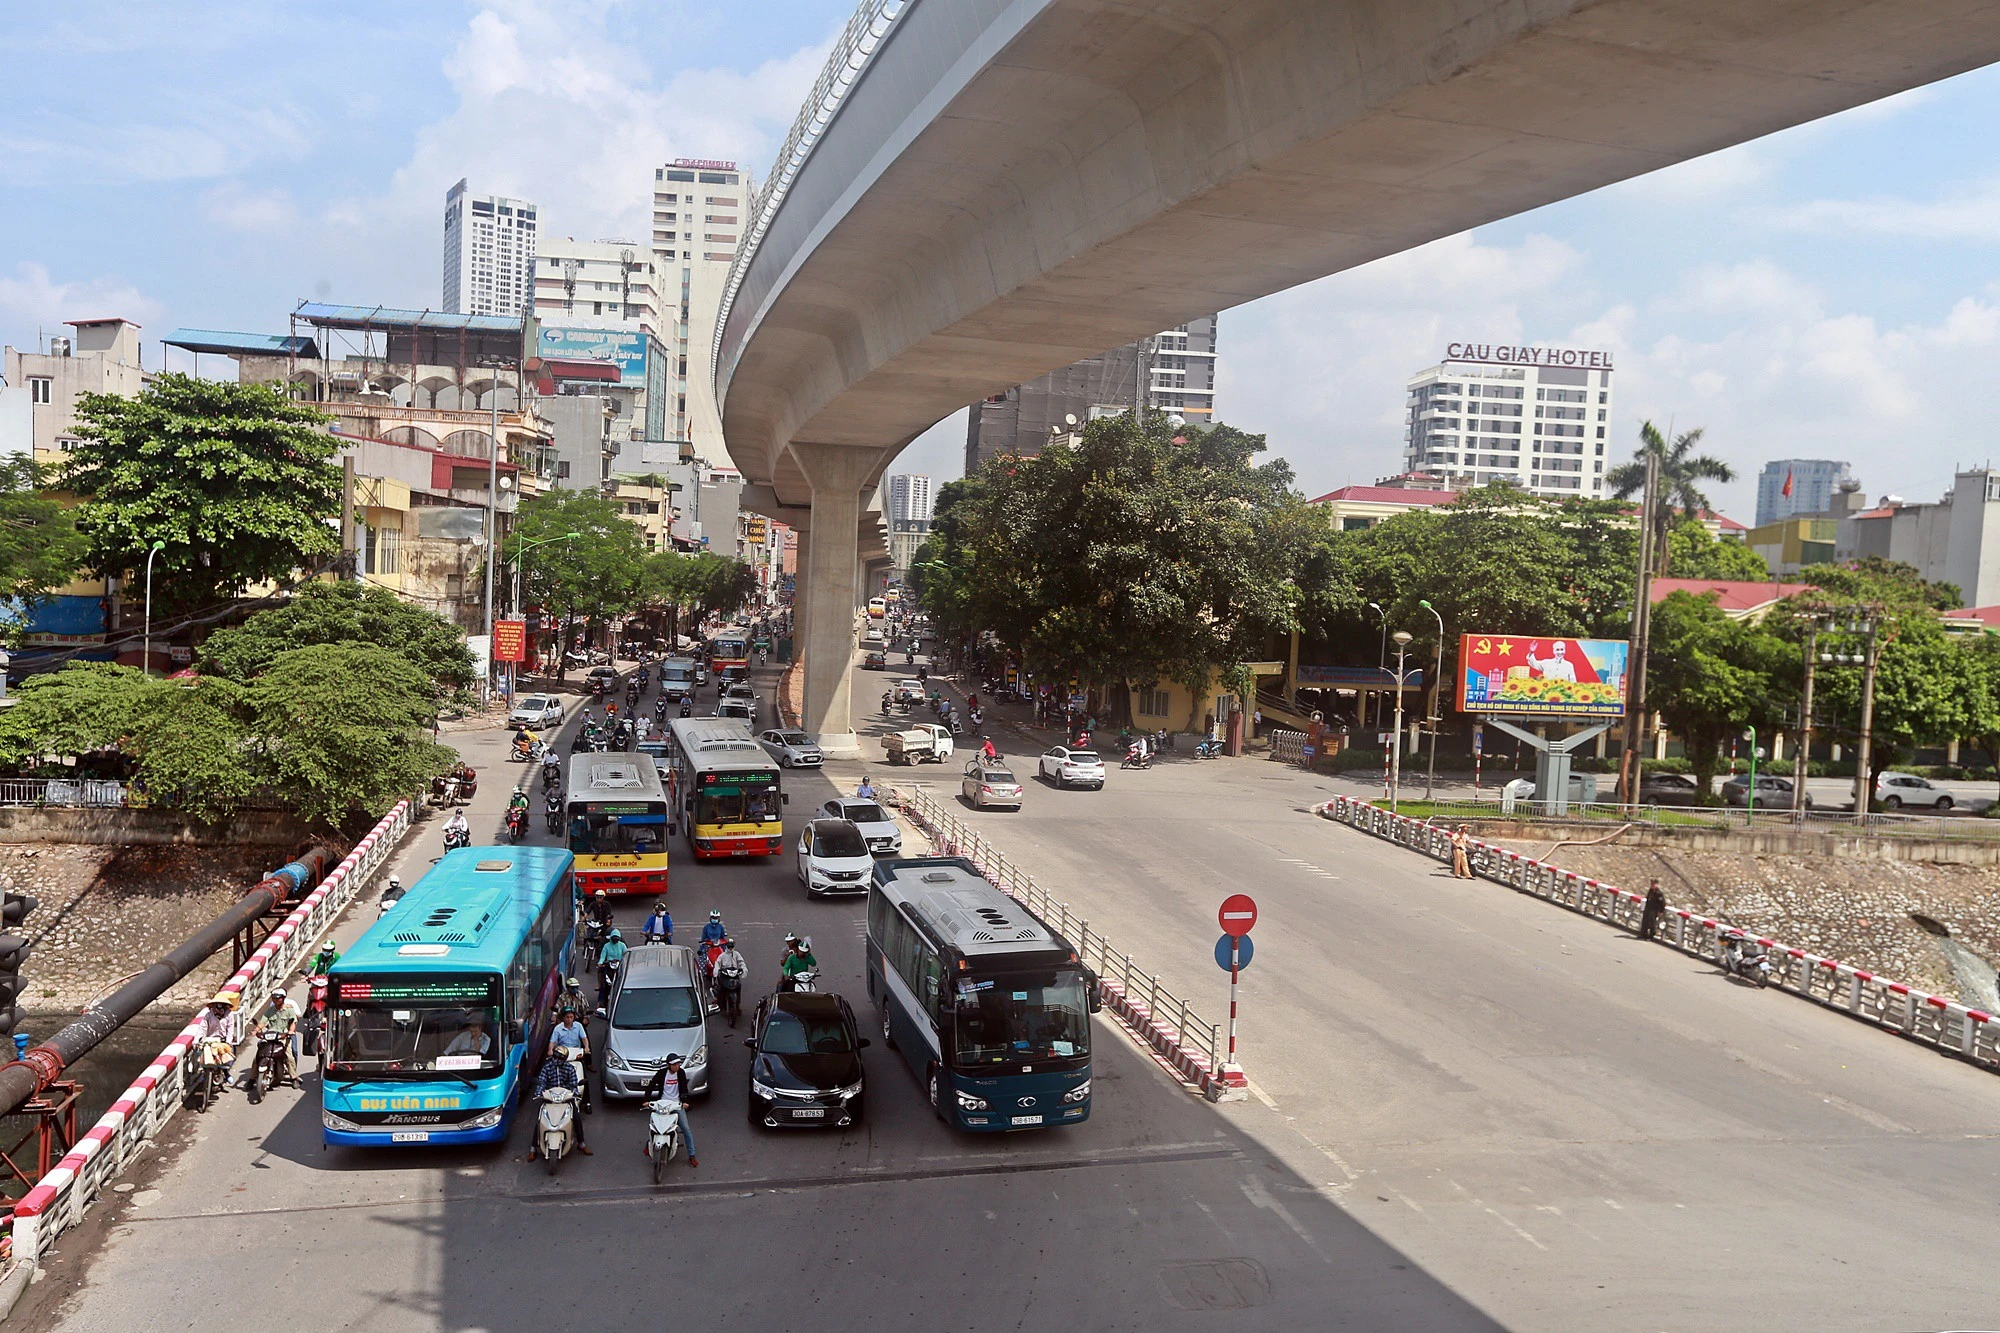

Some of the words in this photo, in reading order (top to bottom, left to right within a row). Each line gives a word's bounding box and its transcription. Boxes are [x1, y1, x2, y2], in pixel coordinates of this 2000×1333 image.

[1448, 343, 1490, 359] CAU
[1496, 346, 1542, 362] GIAY
[1548, 348, 1612, 367] HOTEL
[361, 1099, 387, 1109] BUS
[391, 1095, 420, 1109] LIÊN
[425, 1098, 459, 1108] NINH
